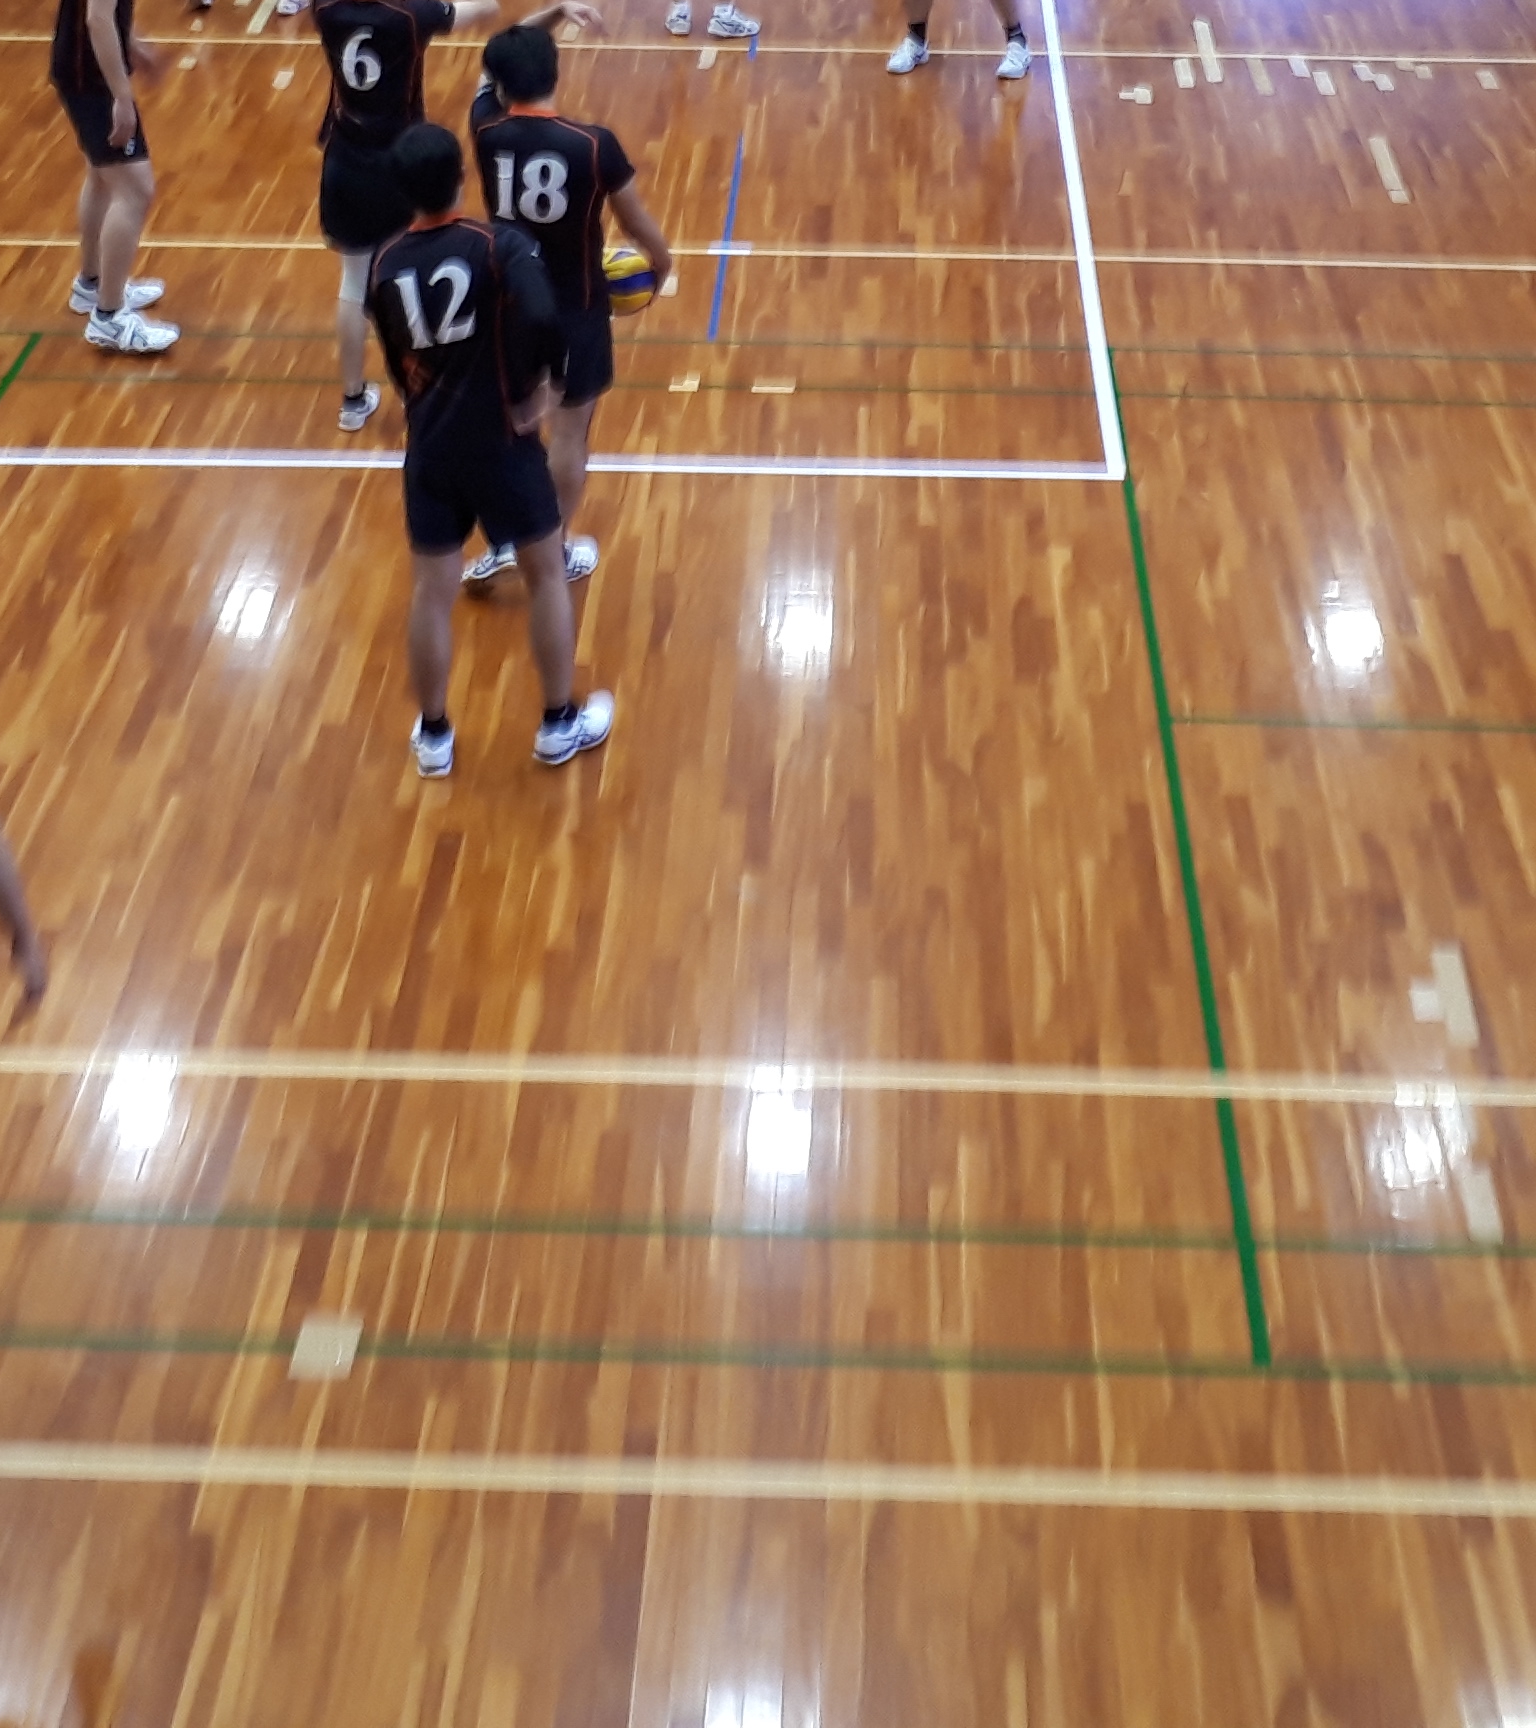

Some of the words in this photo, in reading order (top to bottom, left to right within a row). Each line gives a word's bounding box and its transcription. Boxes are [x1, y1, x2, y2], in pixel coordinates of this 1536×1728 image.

[342, 26, 382, 92] 6
[494, 150, 570, 225] 18
[394, 256, 476, 351] 12
